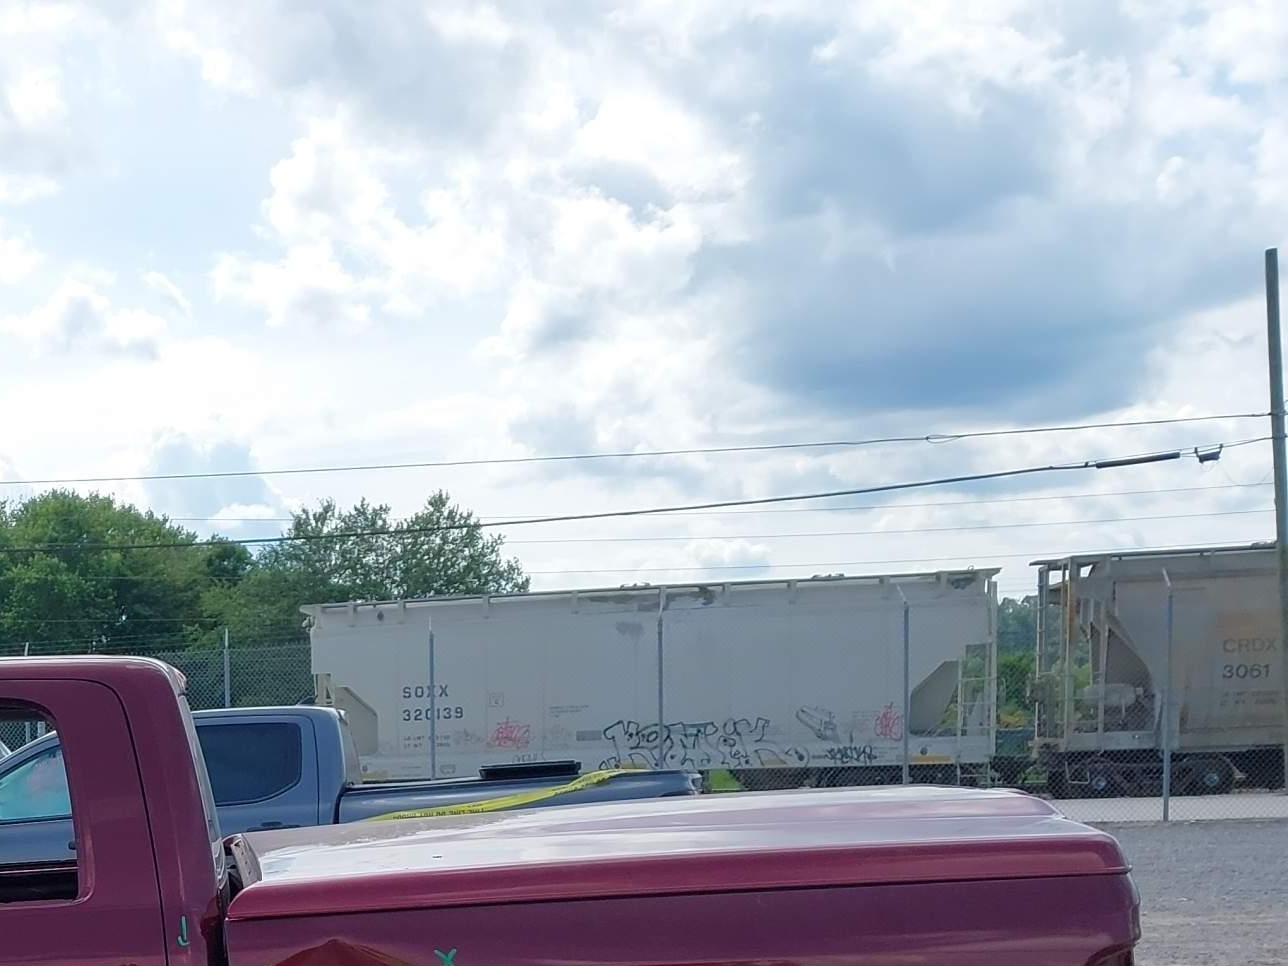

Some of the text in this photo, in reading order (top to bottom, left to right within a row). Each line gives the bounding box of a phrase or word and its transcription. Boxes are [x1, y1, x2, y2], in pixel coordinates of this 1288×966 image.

[1223, 638, 1277, 653] CRDX
[1222, 663, 1271, 679] 3061
[402, 706, 464, 721] 320139
